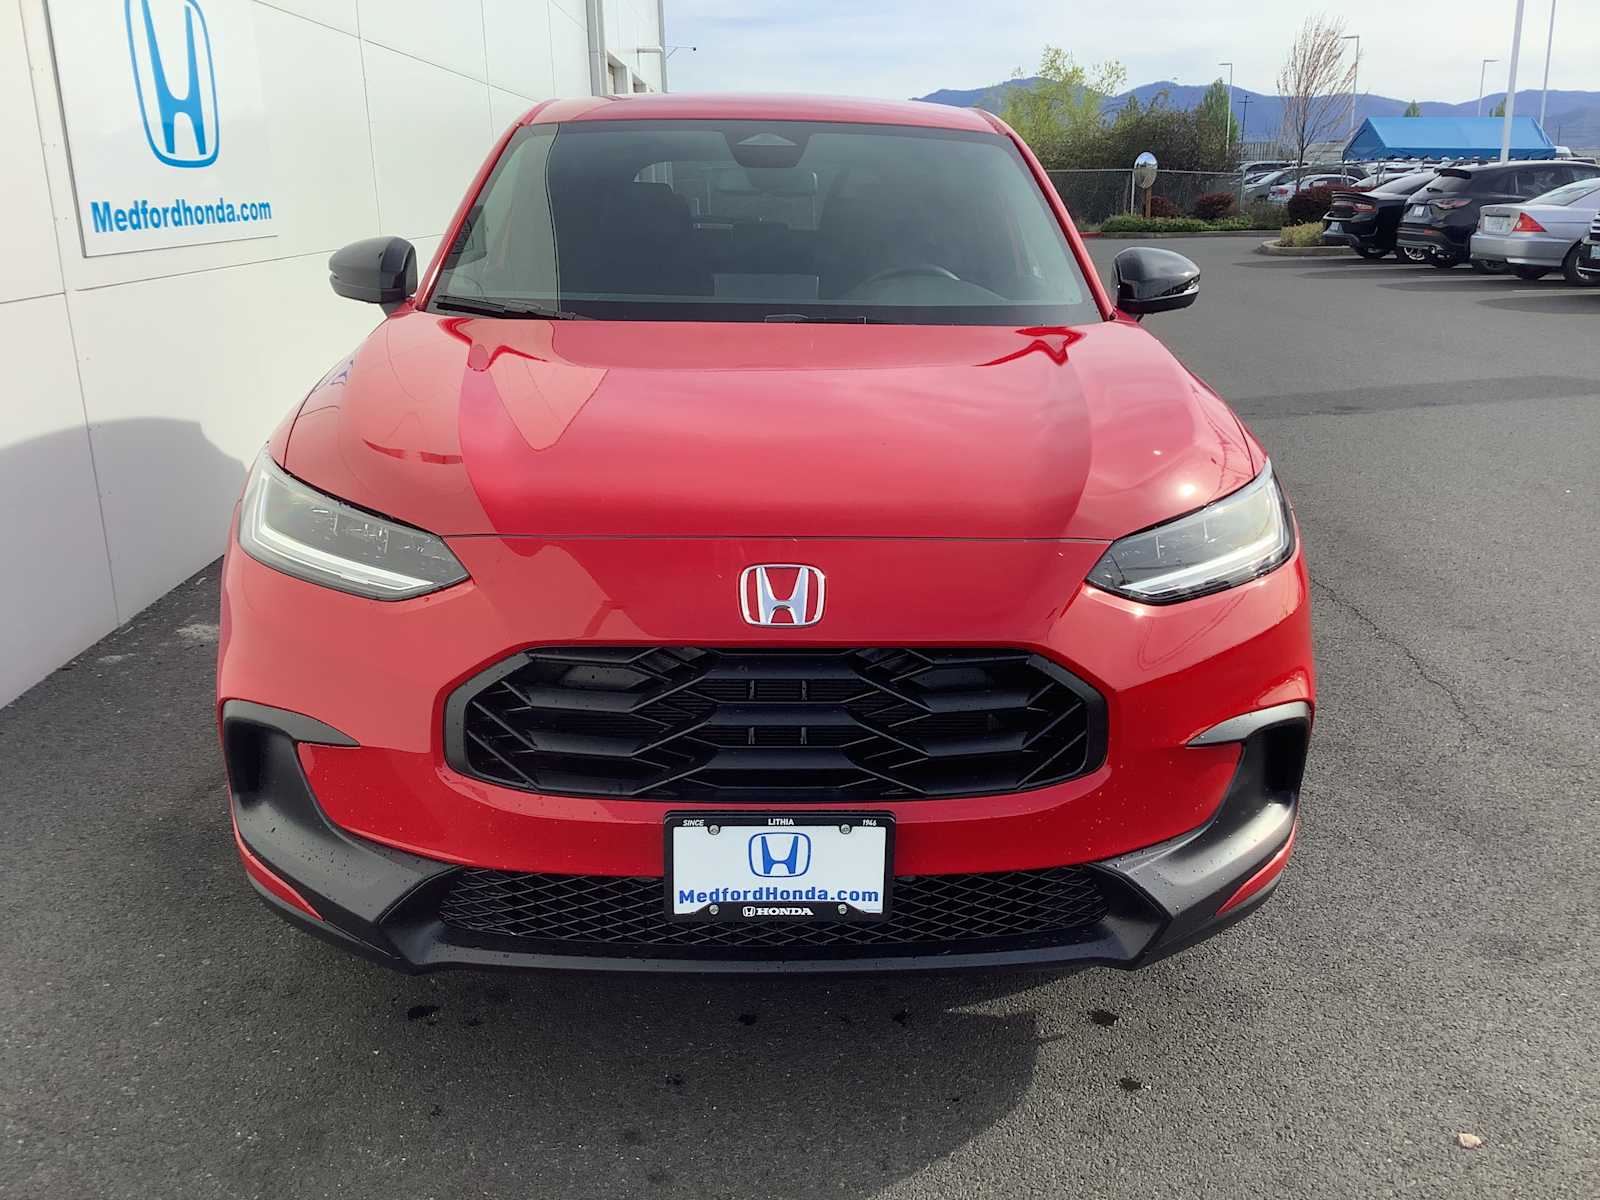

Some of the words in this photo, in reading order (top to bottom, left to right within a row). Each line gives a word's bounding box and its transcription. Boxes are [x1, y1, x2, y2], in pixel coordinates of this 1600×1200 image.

[91, 198, 272, 233] Medfordhonda.com
[682, 819, 704, 827] SINCE
[768, 818, 794, 826] LITHIA
[862, 819, 877, 827] 1946
[679, 887, 879, 904] MedfordHonda.com
[756, 908, 814, 916] HONDA
